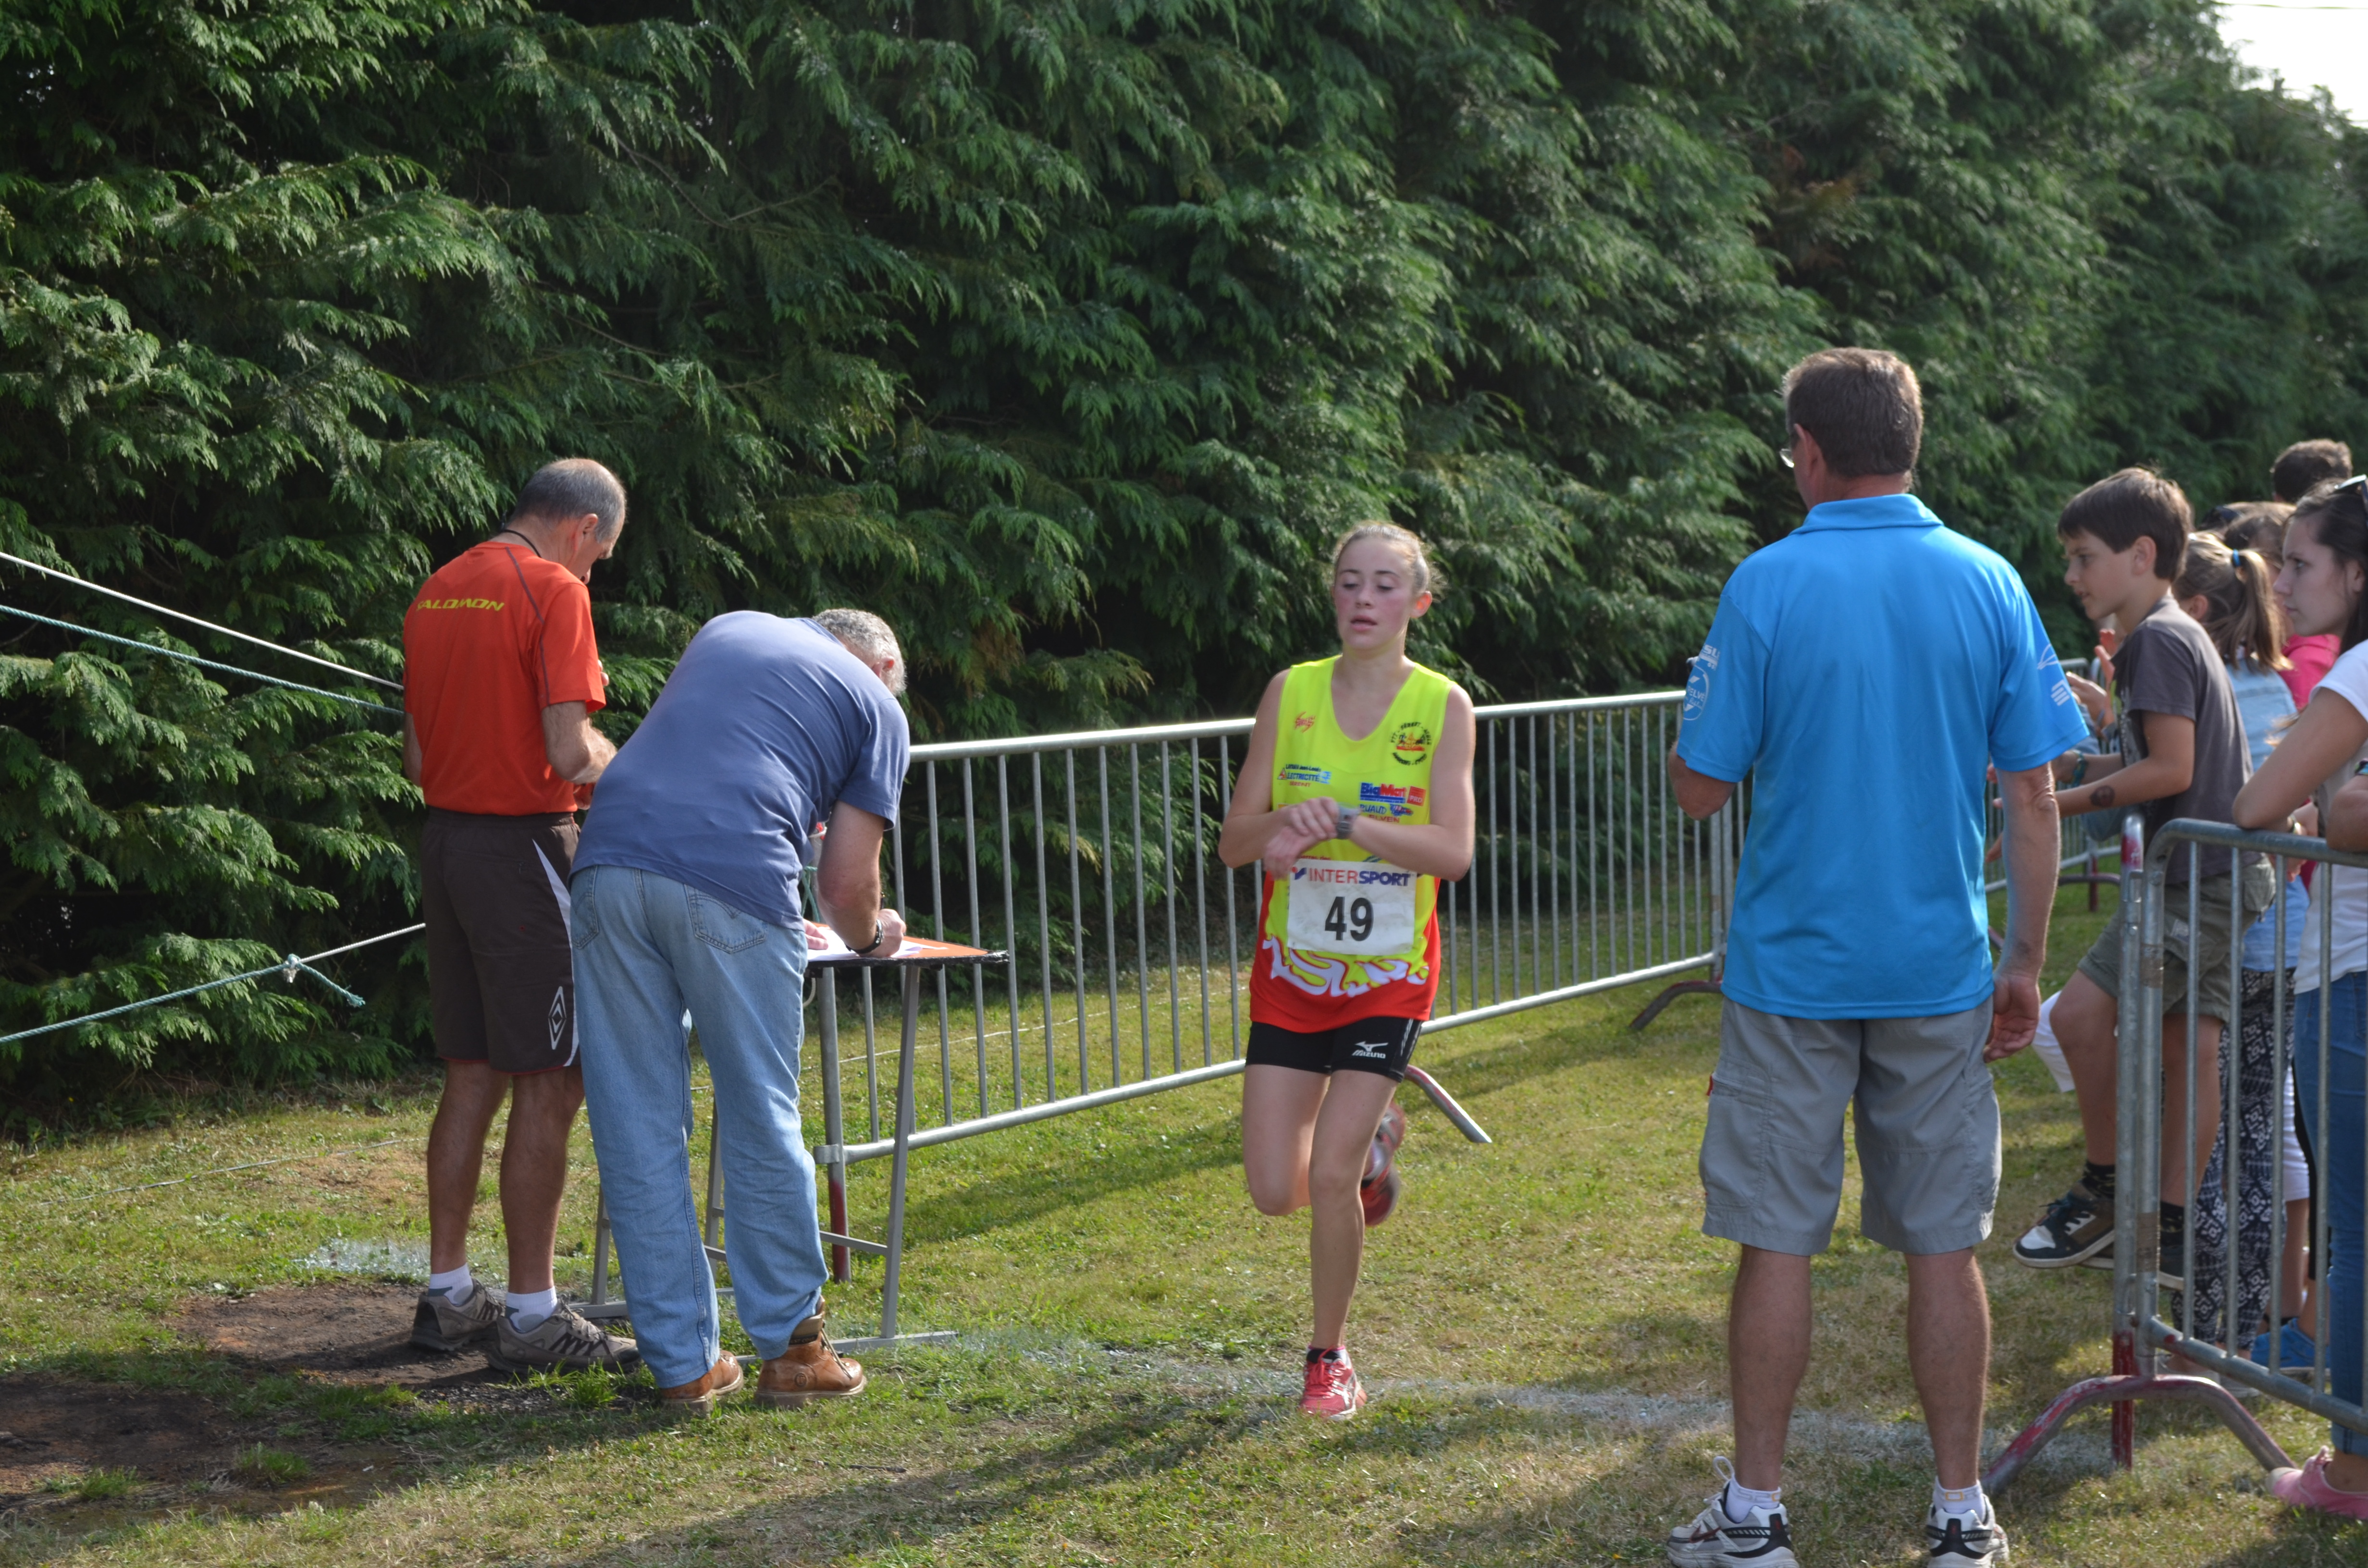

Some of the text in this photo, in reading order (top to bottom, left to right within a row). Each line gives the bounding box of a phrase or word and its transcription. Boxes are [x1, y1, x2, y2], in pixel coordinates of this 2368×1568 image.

[416, 598, 505, 612] SALOMON
[1309, 867, 1411, 886] INTERSPORT
[1325, 896, 1374, 942] 49
